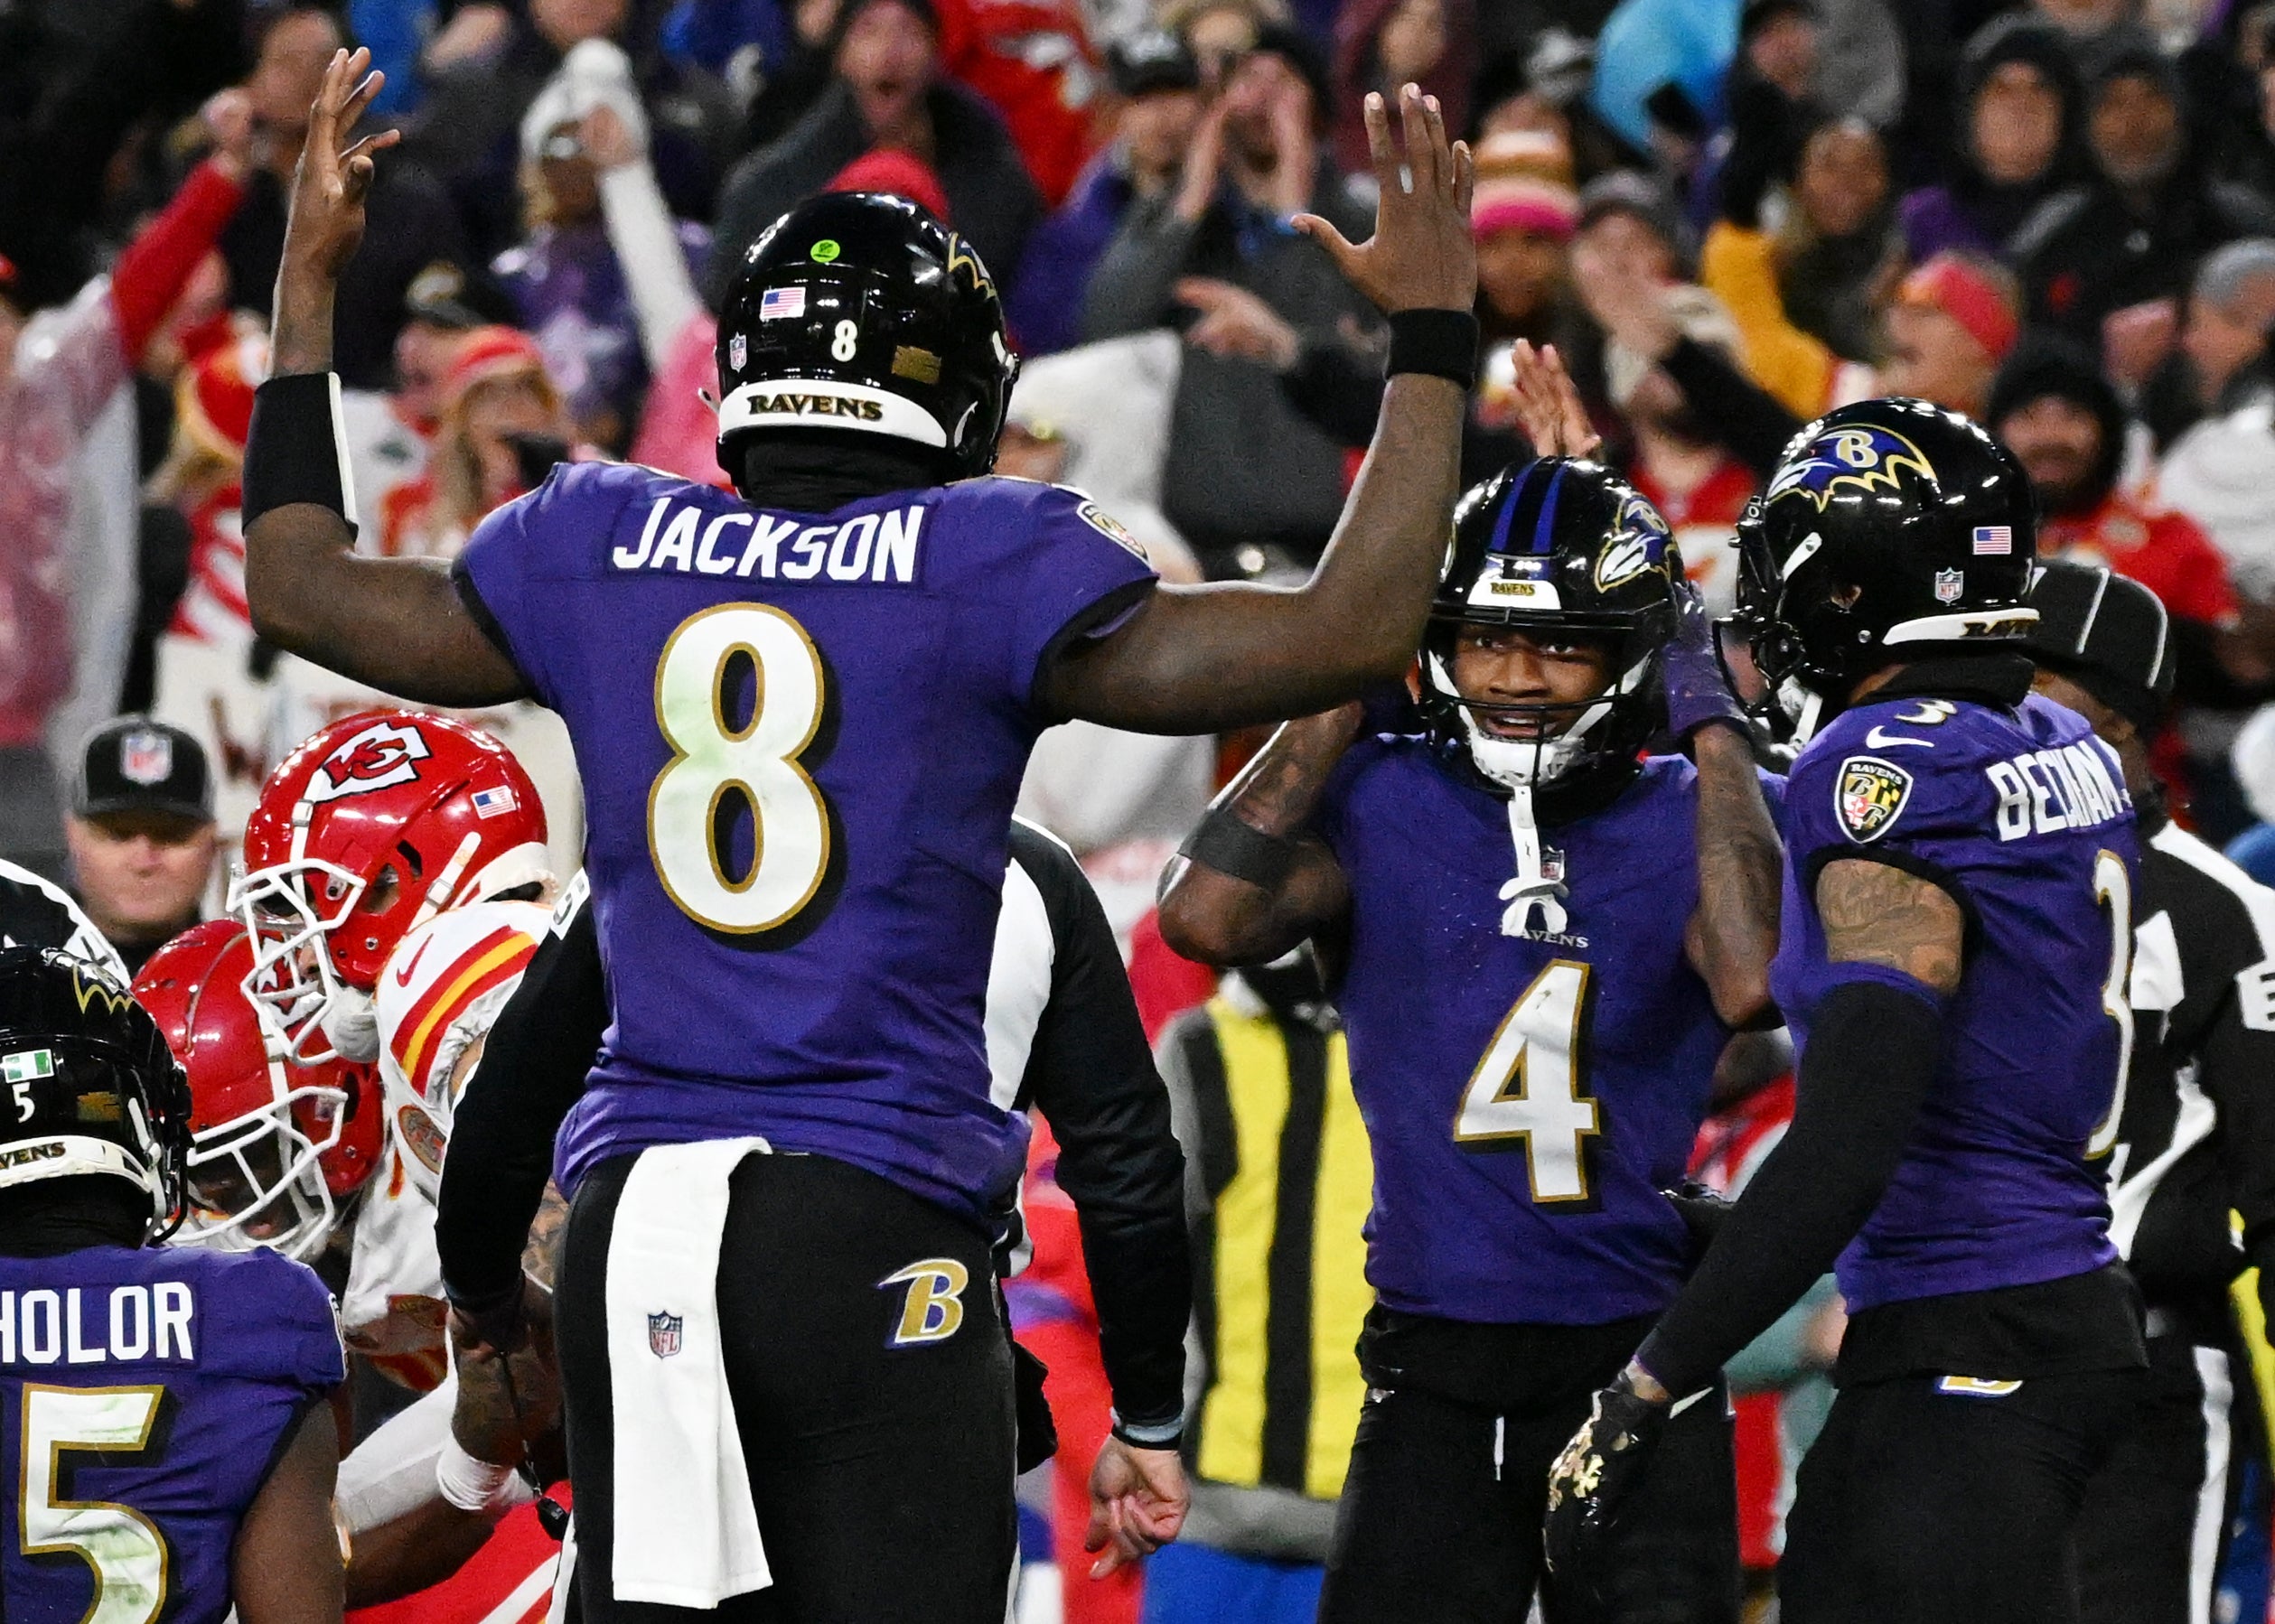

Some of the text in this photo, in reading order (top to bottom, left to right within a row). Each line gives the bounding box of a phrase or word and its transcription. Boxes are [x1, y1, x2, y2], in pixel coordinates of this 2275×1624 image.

[830, 319, 858, 362] 8
[746, 393, 883, 421] RAVENS
[613, 497, 925, 583] JACKSON
[1490, 582, 1536, 597] RAVENS
[1894, 699, 1958, 725] 3
[646, 601, 831, 936] 8
[1850, 763, 1903, 785] RAVENS
[1453, 957, 1601, 1203] 4
[12, 1081, 36, 1125] 5
[0, 1141, 67, 1171] VENS
[876, 1258, 969, 1344] B
[651, 1331, 679, 1354] NFL
[18, 1382, 169, 1624] 5
